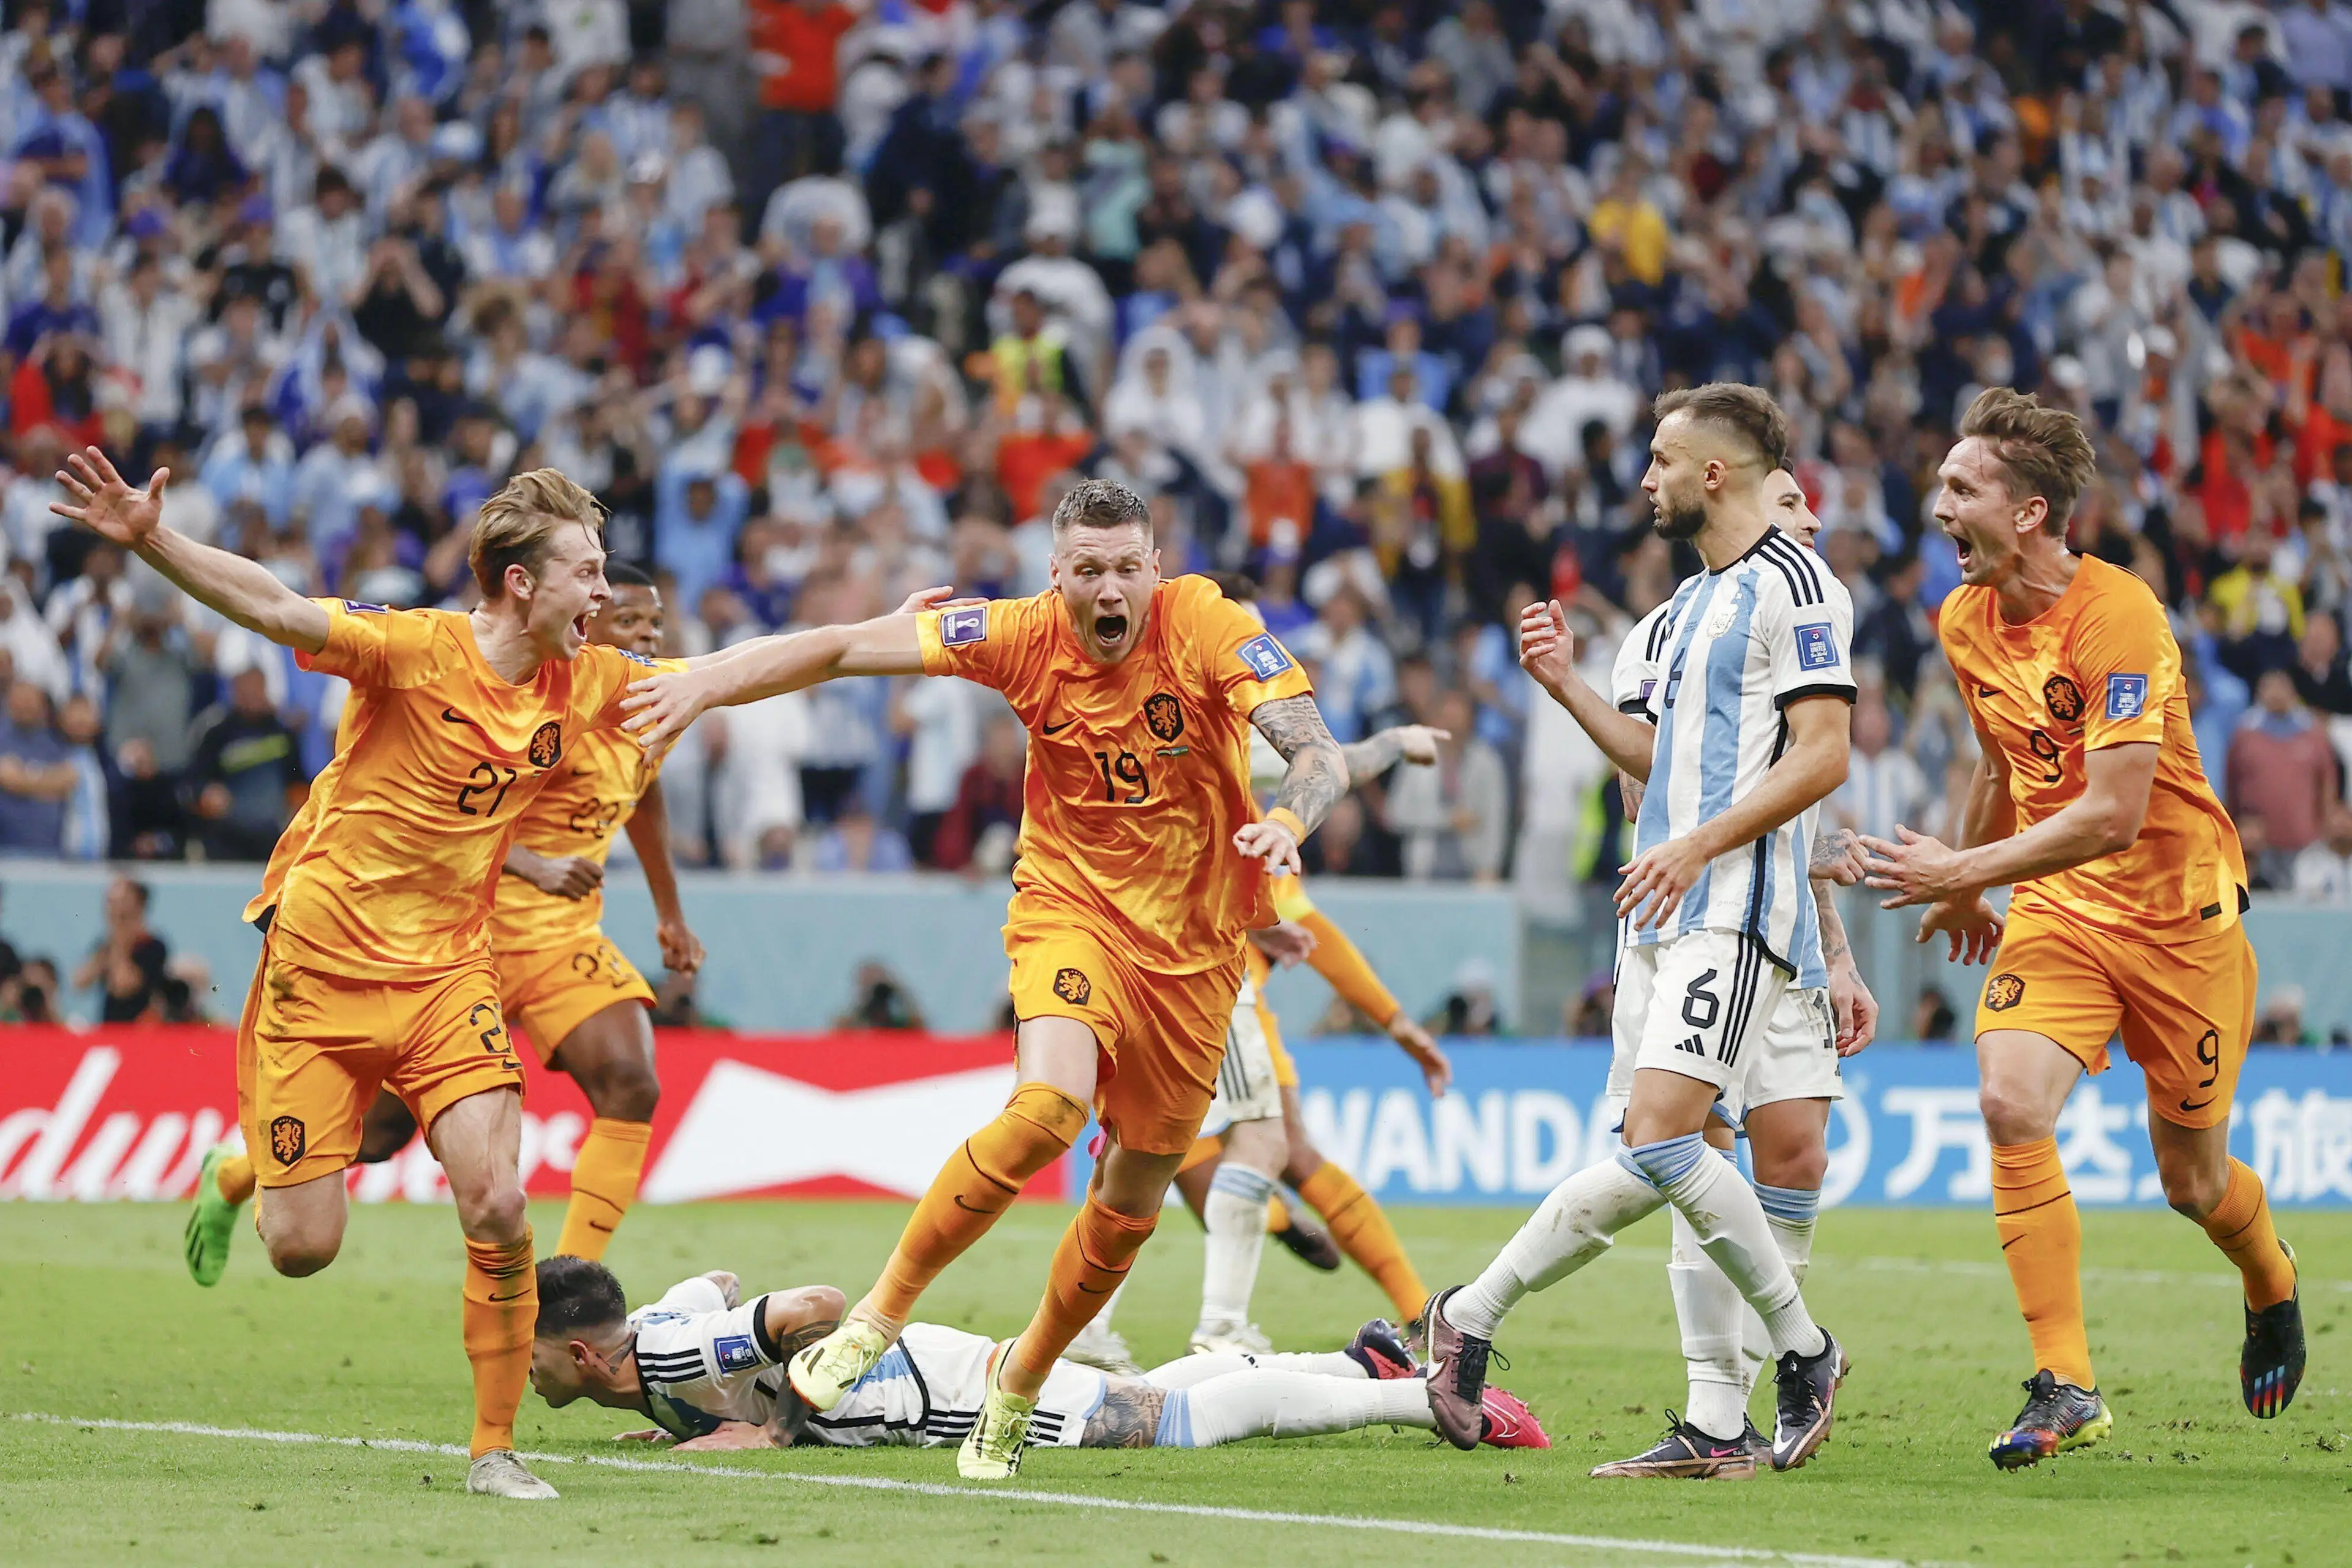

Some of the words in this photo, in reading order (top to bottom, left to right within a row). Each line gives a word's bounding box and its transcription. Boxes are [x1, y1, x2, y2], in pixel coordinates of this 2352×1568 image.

[1664, 647, 1686, 709] 6
[1094, 752, 1150, 804] 19
[2030, 729, 2063, 783] 9
[456, 761, 516, 818] 21
[1681, 968, 1720, 1030] 6
[2197, 1029, 2218, 1088] 9
